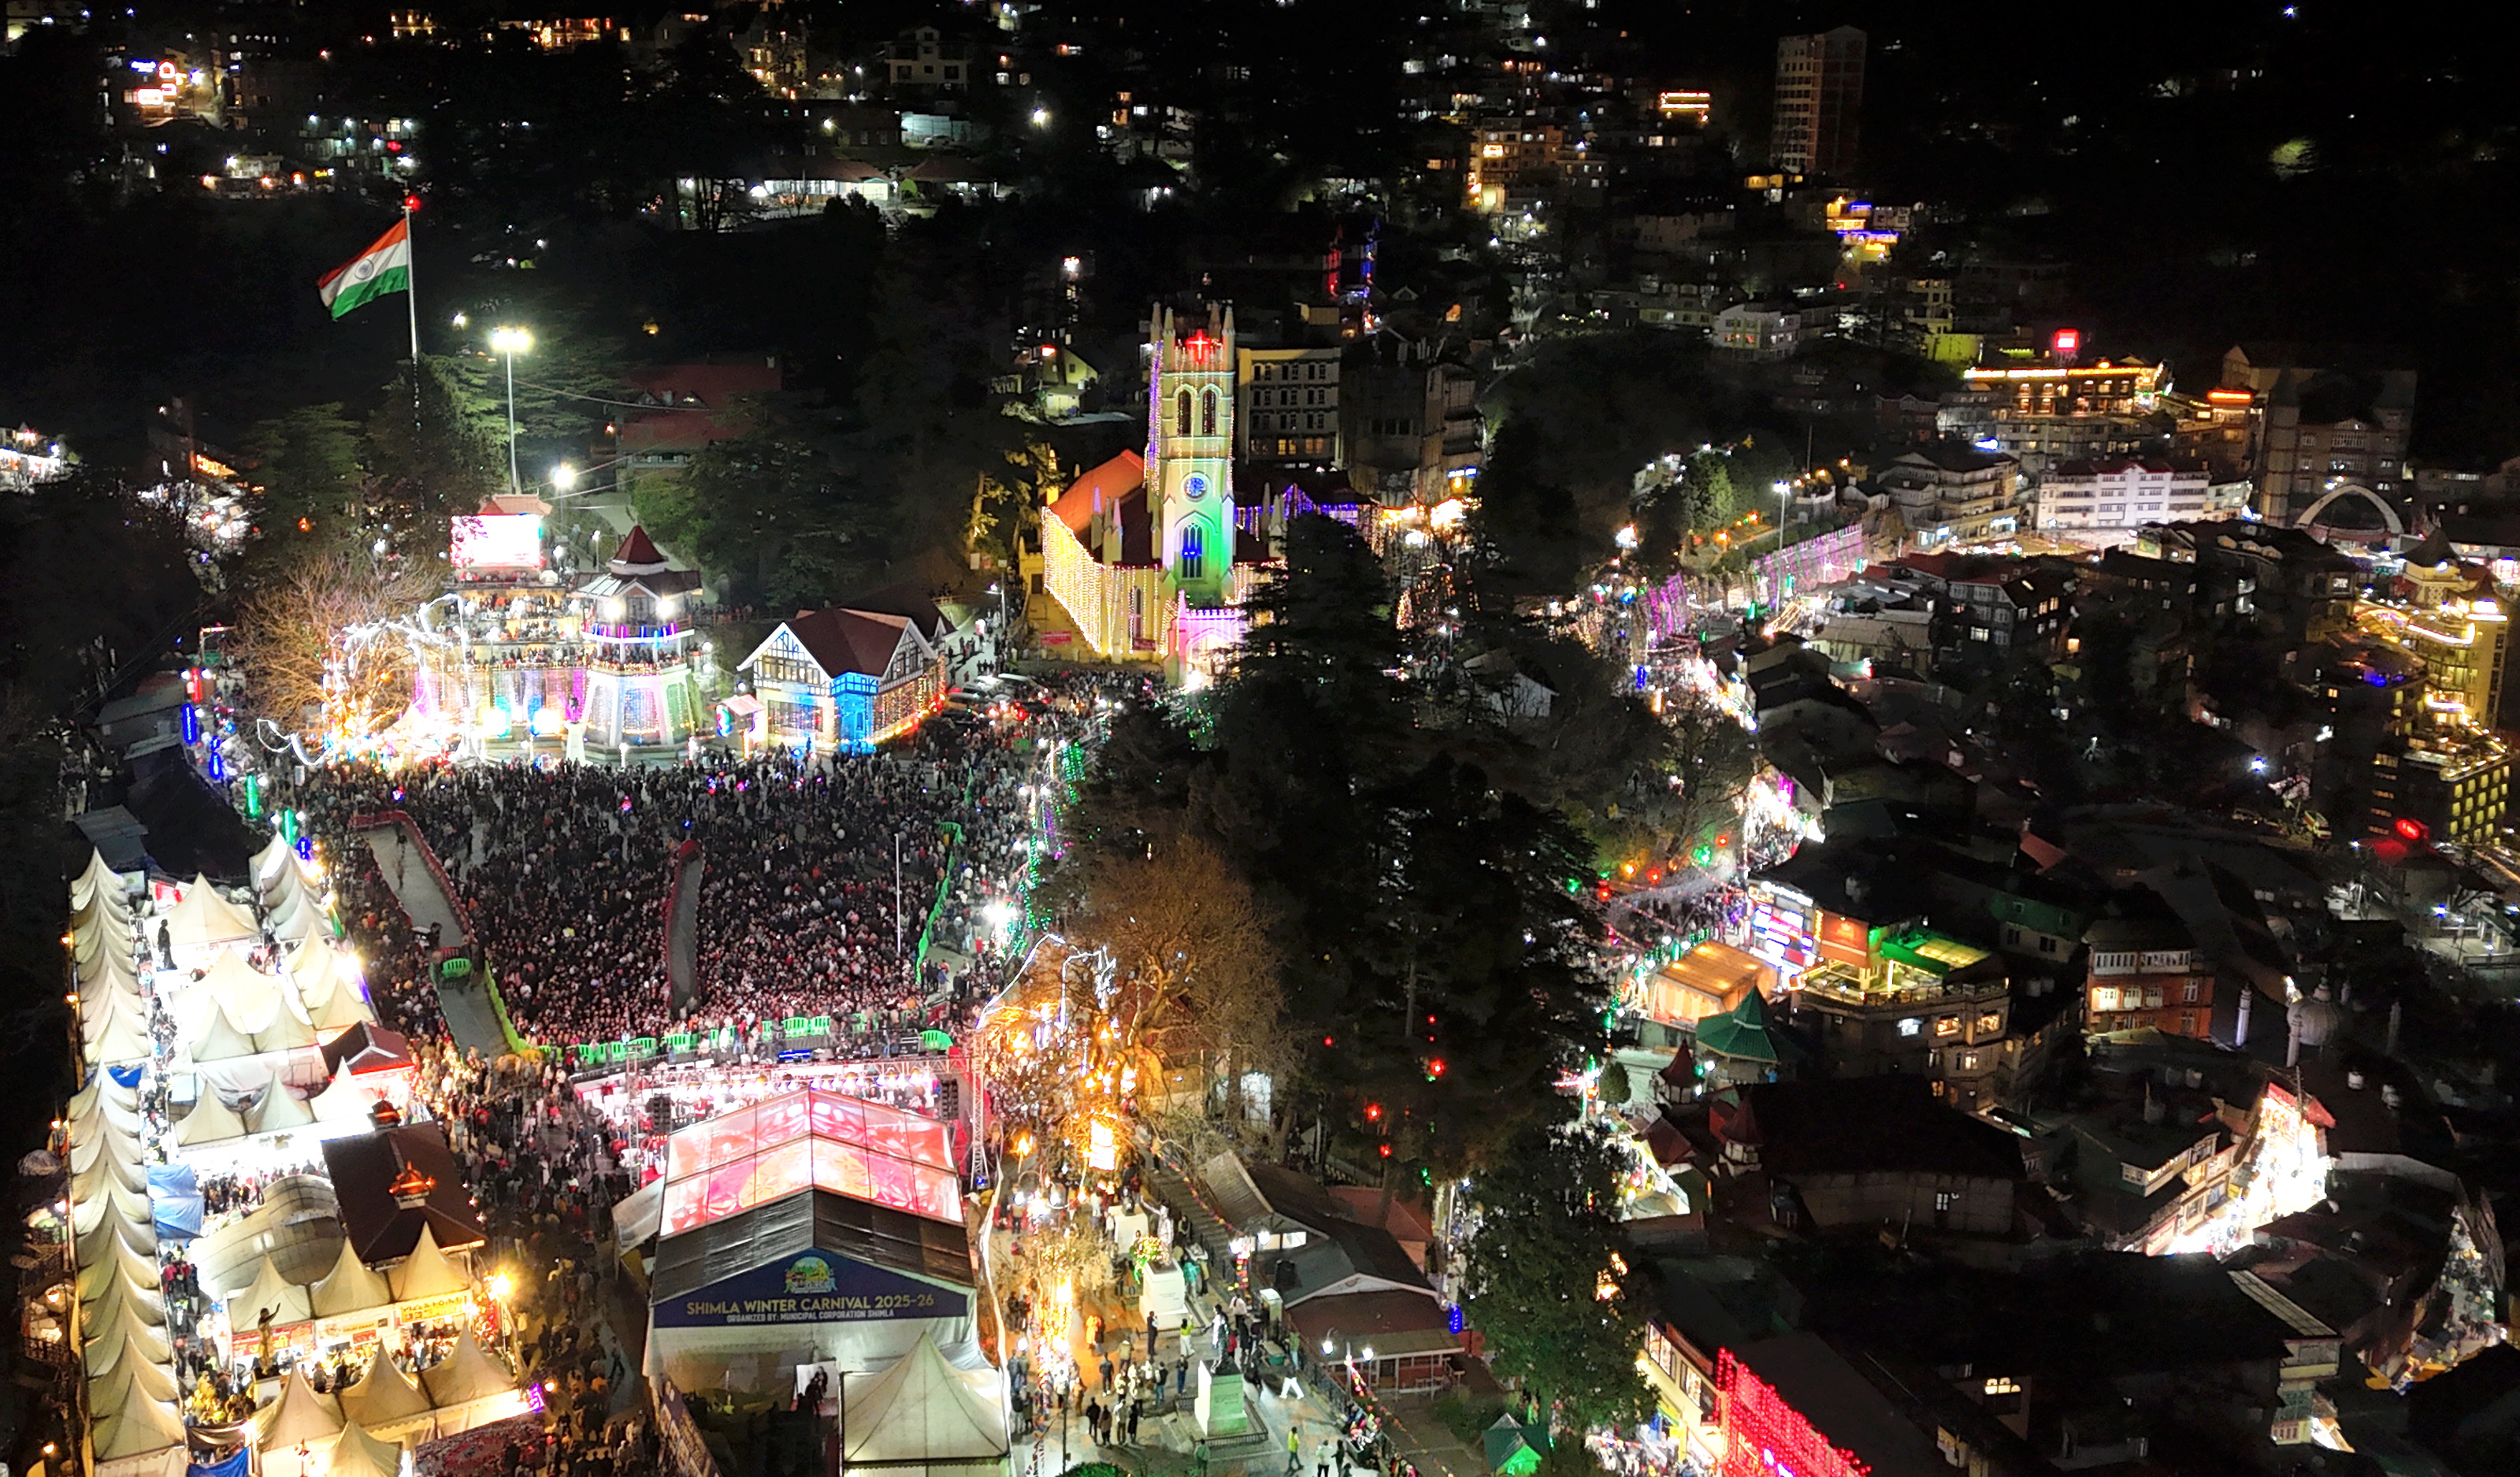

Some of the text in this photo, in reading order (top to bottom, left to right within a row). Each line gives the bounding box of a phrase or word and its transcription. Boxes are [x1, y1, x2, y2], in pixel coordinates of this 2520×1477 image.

[686, 1293, 934, 1315] SHIMLA WINTER CARNIVAL 2025-26
[726, 1308, 895, 1323] ORGANIZED BY: MUNICIPAL CORPORATION SHIMLA
